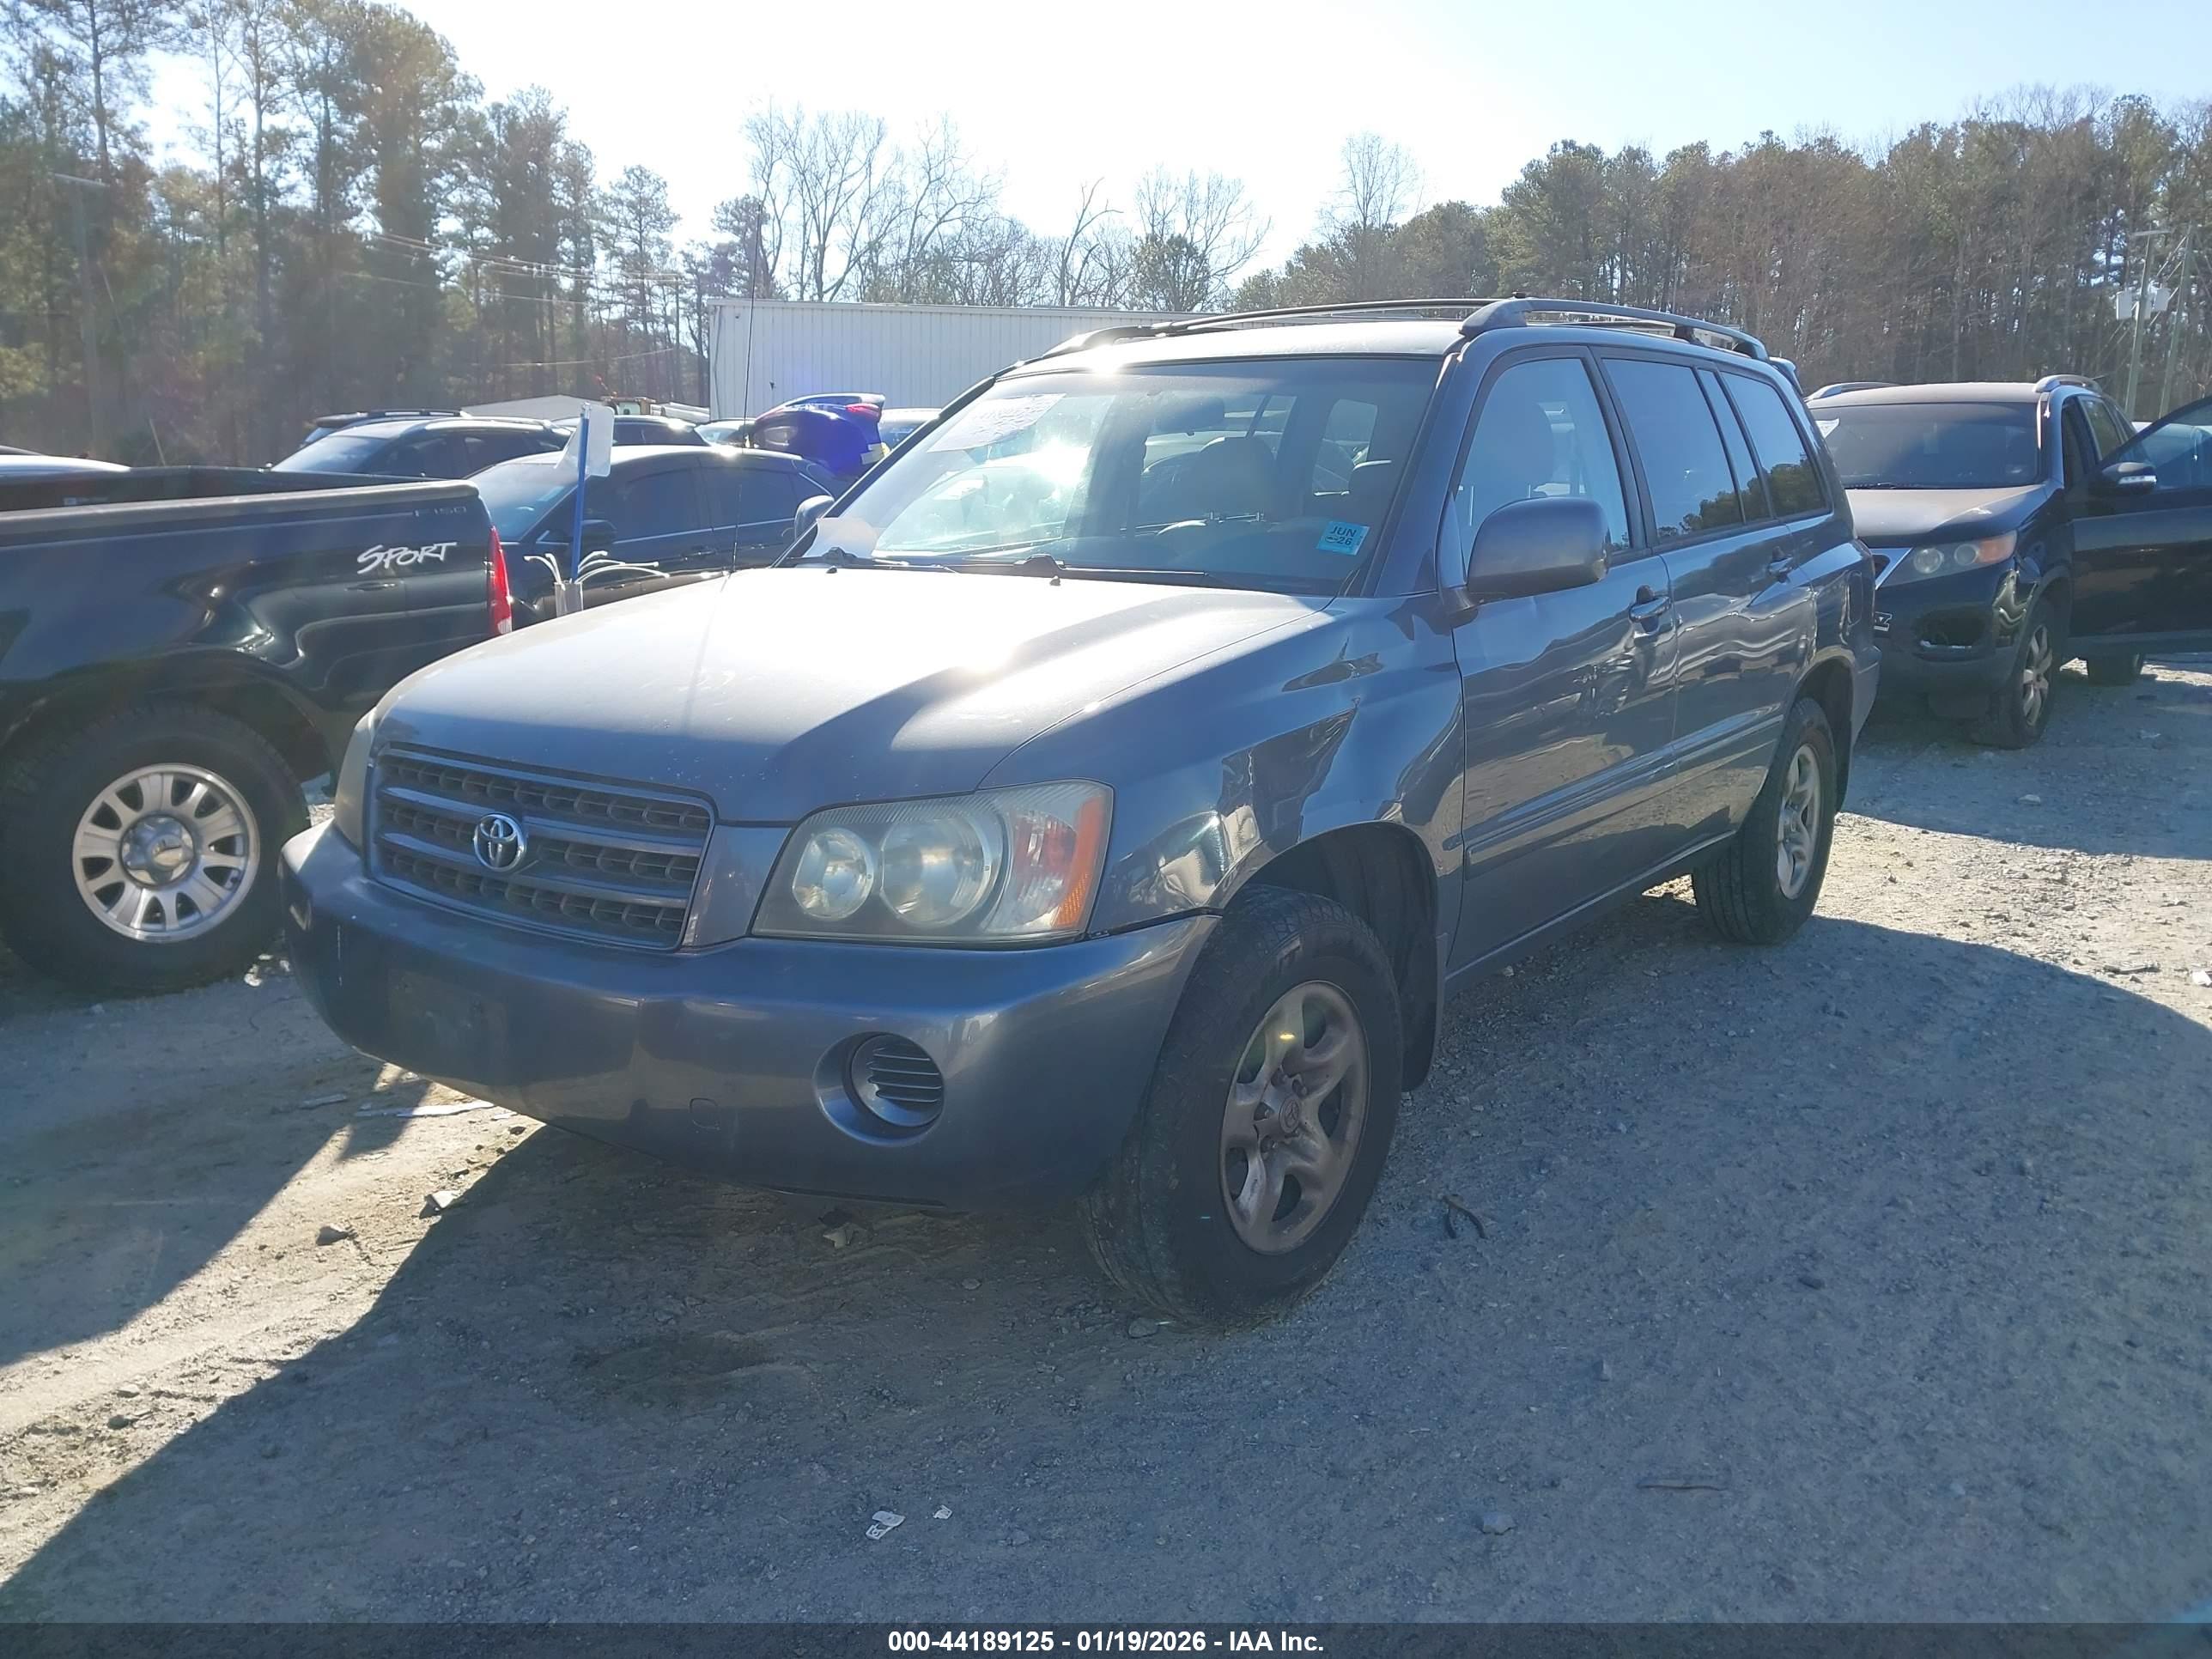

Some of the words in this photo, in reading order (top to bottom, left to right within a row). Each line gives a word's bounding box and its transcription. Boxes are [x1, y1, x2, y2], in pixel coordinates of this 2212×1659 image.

[1329, 526, 1357, 538] JUN
[1336, 536, 1353, 546] 26
[356, 542, 458, 574] SPORT
